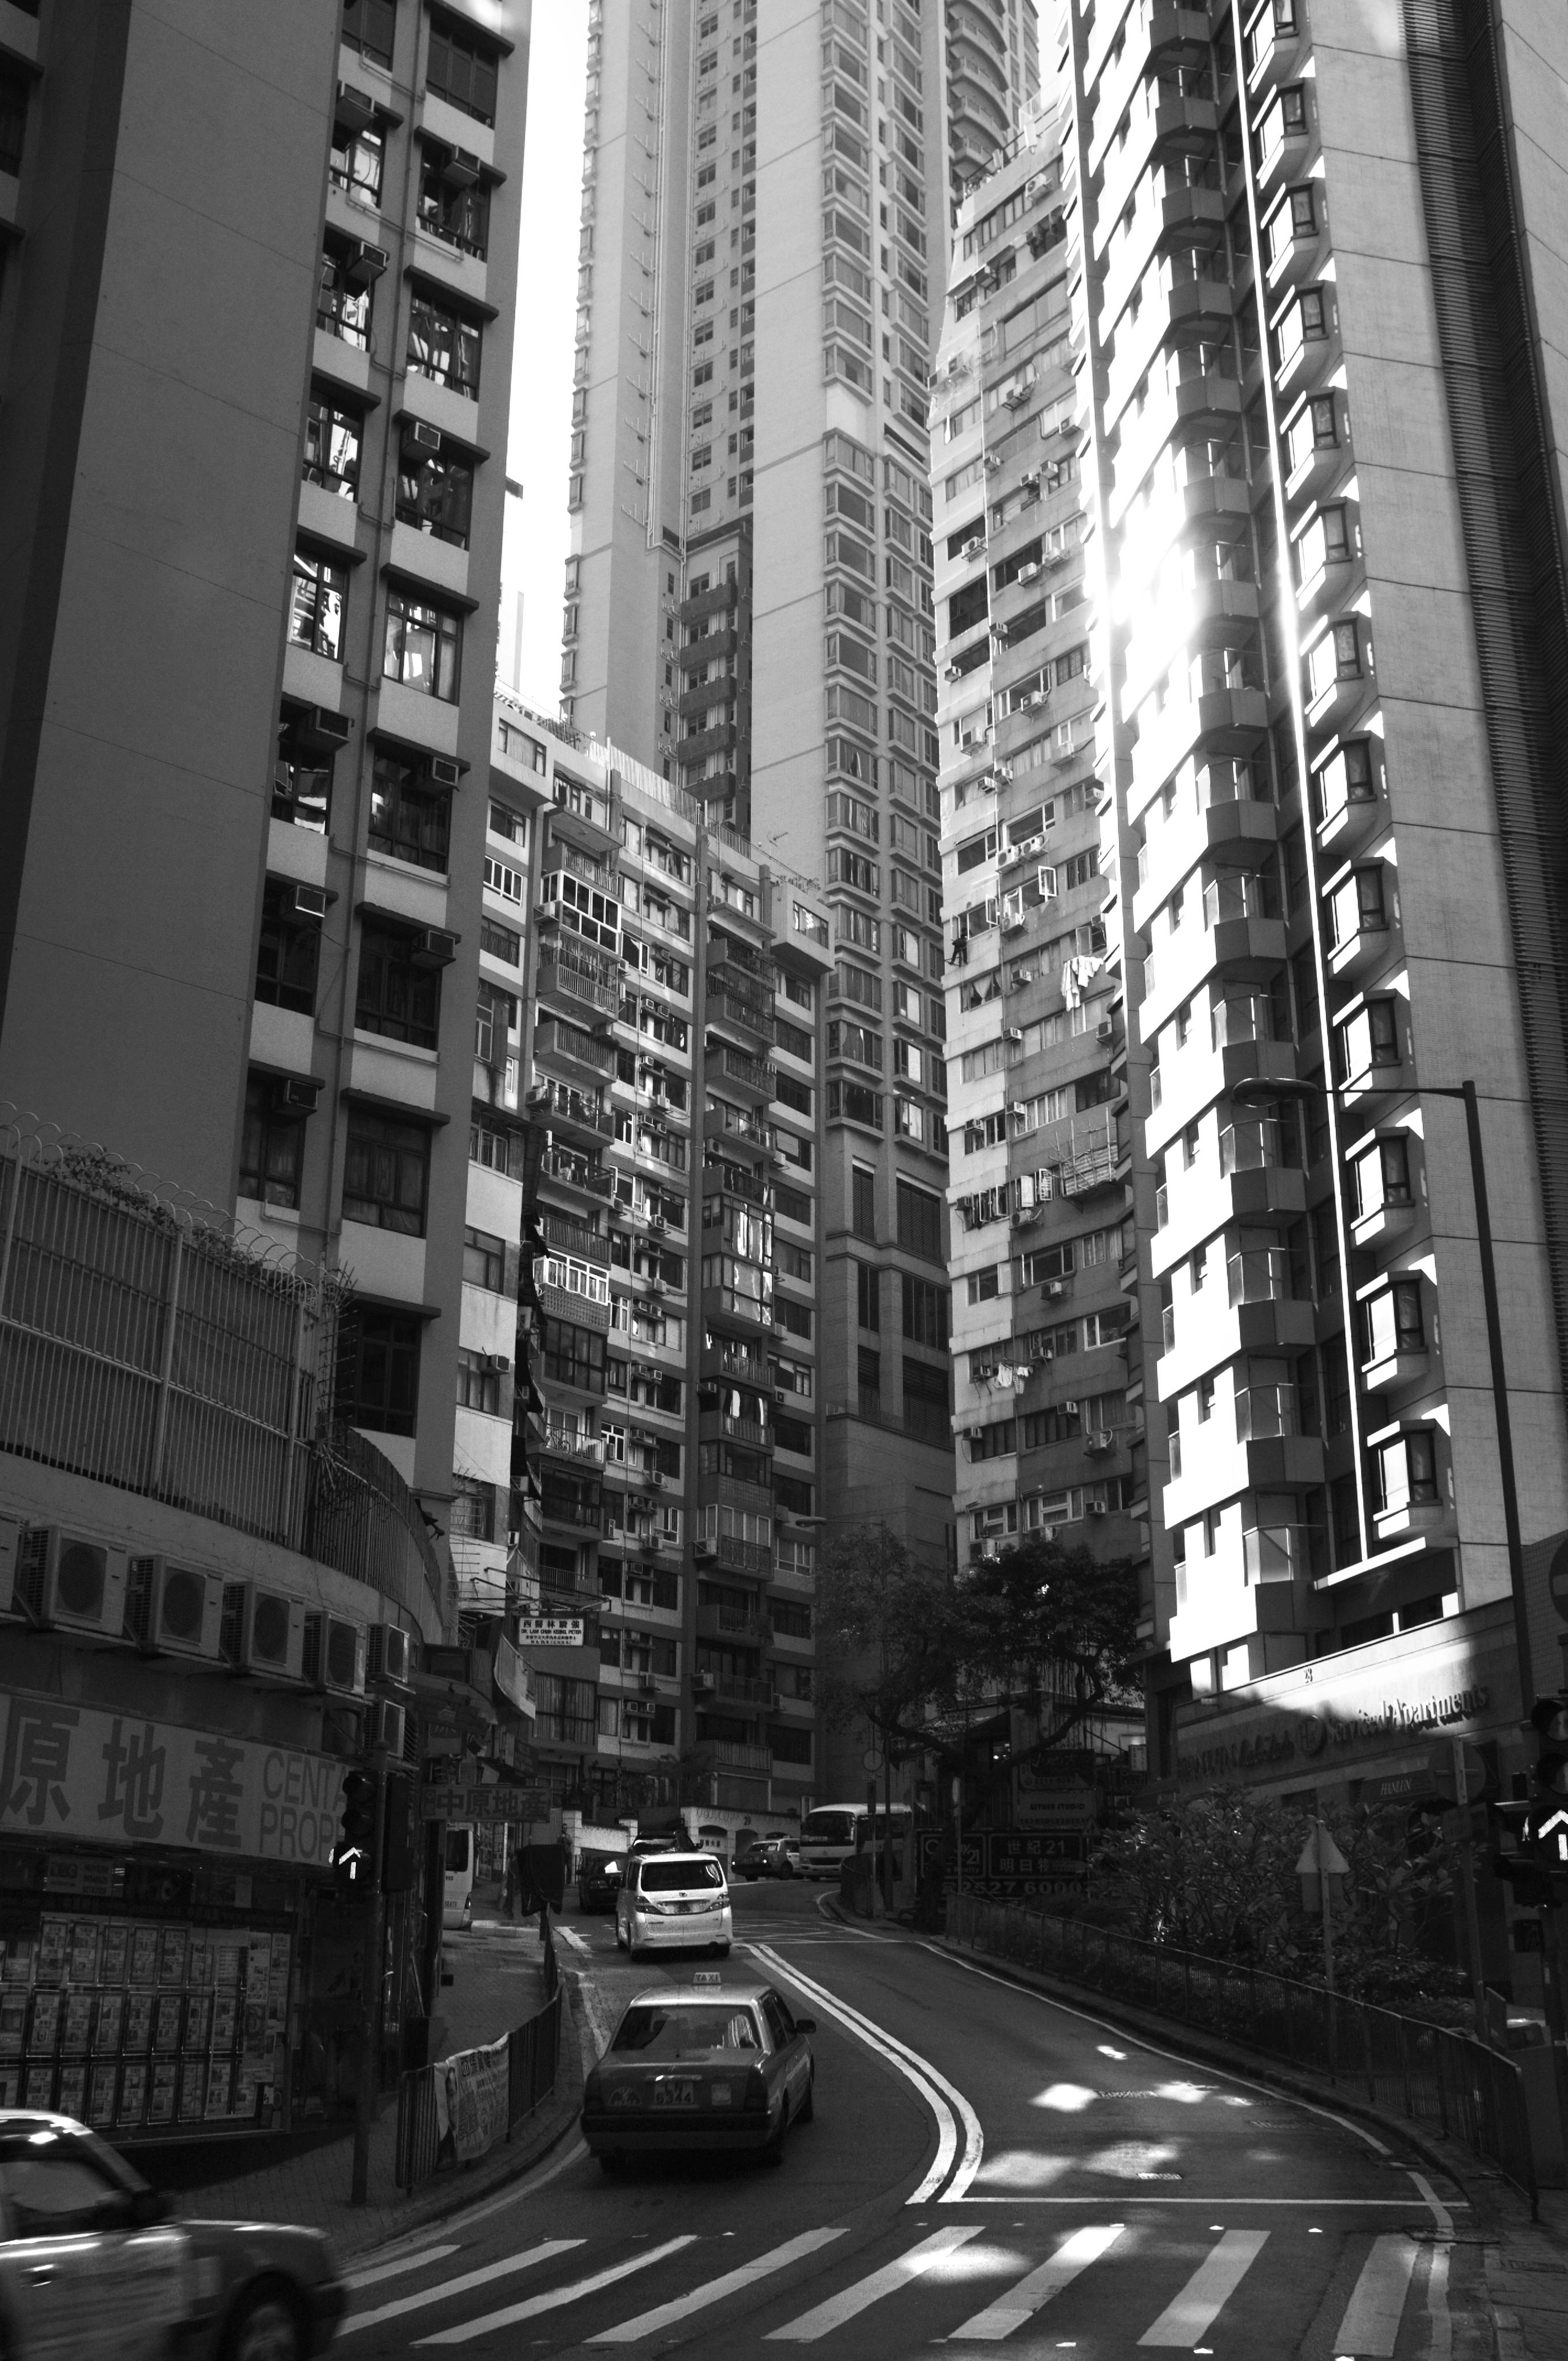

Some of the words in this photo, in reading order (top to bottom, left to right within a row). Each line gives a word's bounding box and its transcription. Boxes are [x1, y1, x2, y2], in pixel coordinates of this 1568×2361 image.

[1303, 1668, 1313, 1684] 28
[1392, 1683, 1490, 1731] Apartments
[0, 1696, 246, 1848] 原地產
[263, 1750, 350, 1811] CENTA
[436, 1788, 549, 1818] 中原地產
[259, 1802, 345, 1864] PROP
[1000, 1857, 1049, 1873] 明日物
